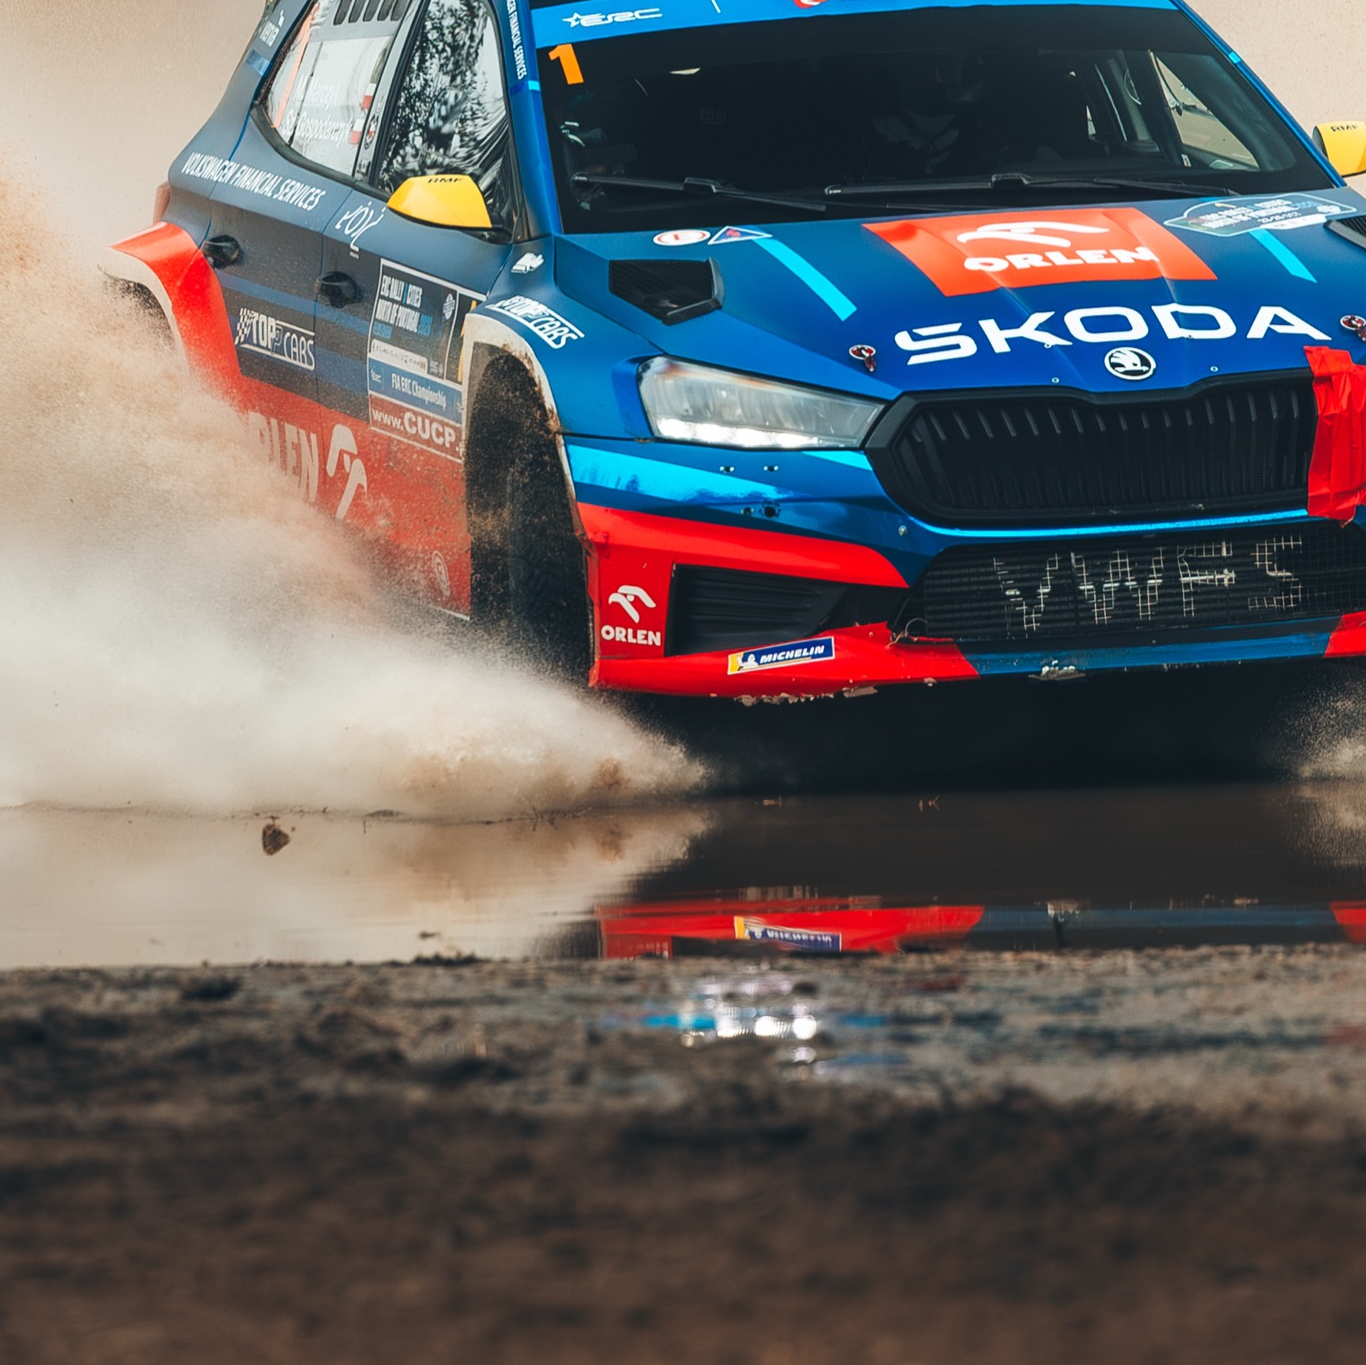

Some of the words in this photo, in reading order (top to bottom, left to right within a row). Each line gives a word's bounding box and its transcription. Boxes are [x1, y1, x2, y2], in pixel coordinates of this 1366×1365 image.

[548, 43, 584, 85] 1
[181, 152, 237, 182] VOLKSWAGEN
[229, 163, 282, 198] FINANCIAL
[272, 178, 326, 211] SERVICES
[964, 245, 1158, 273] ORLEN
[249, 310, 277, 349] TOP
[283, 331, 315, 371] CARS
[529, 317, 579, 349] CARS
[601, 624, 661, 647] ORLEN
[760, 642, 825, 664] MICHELIN
